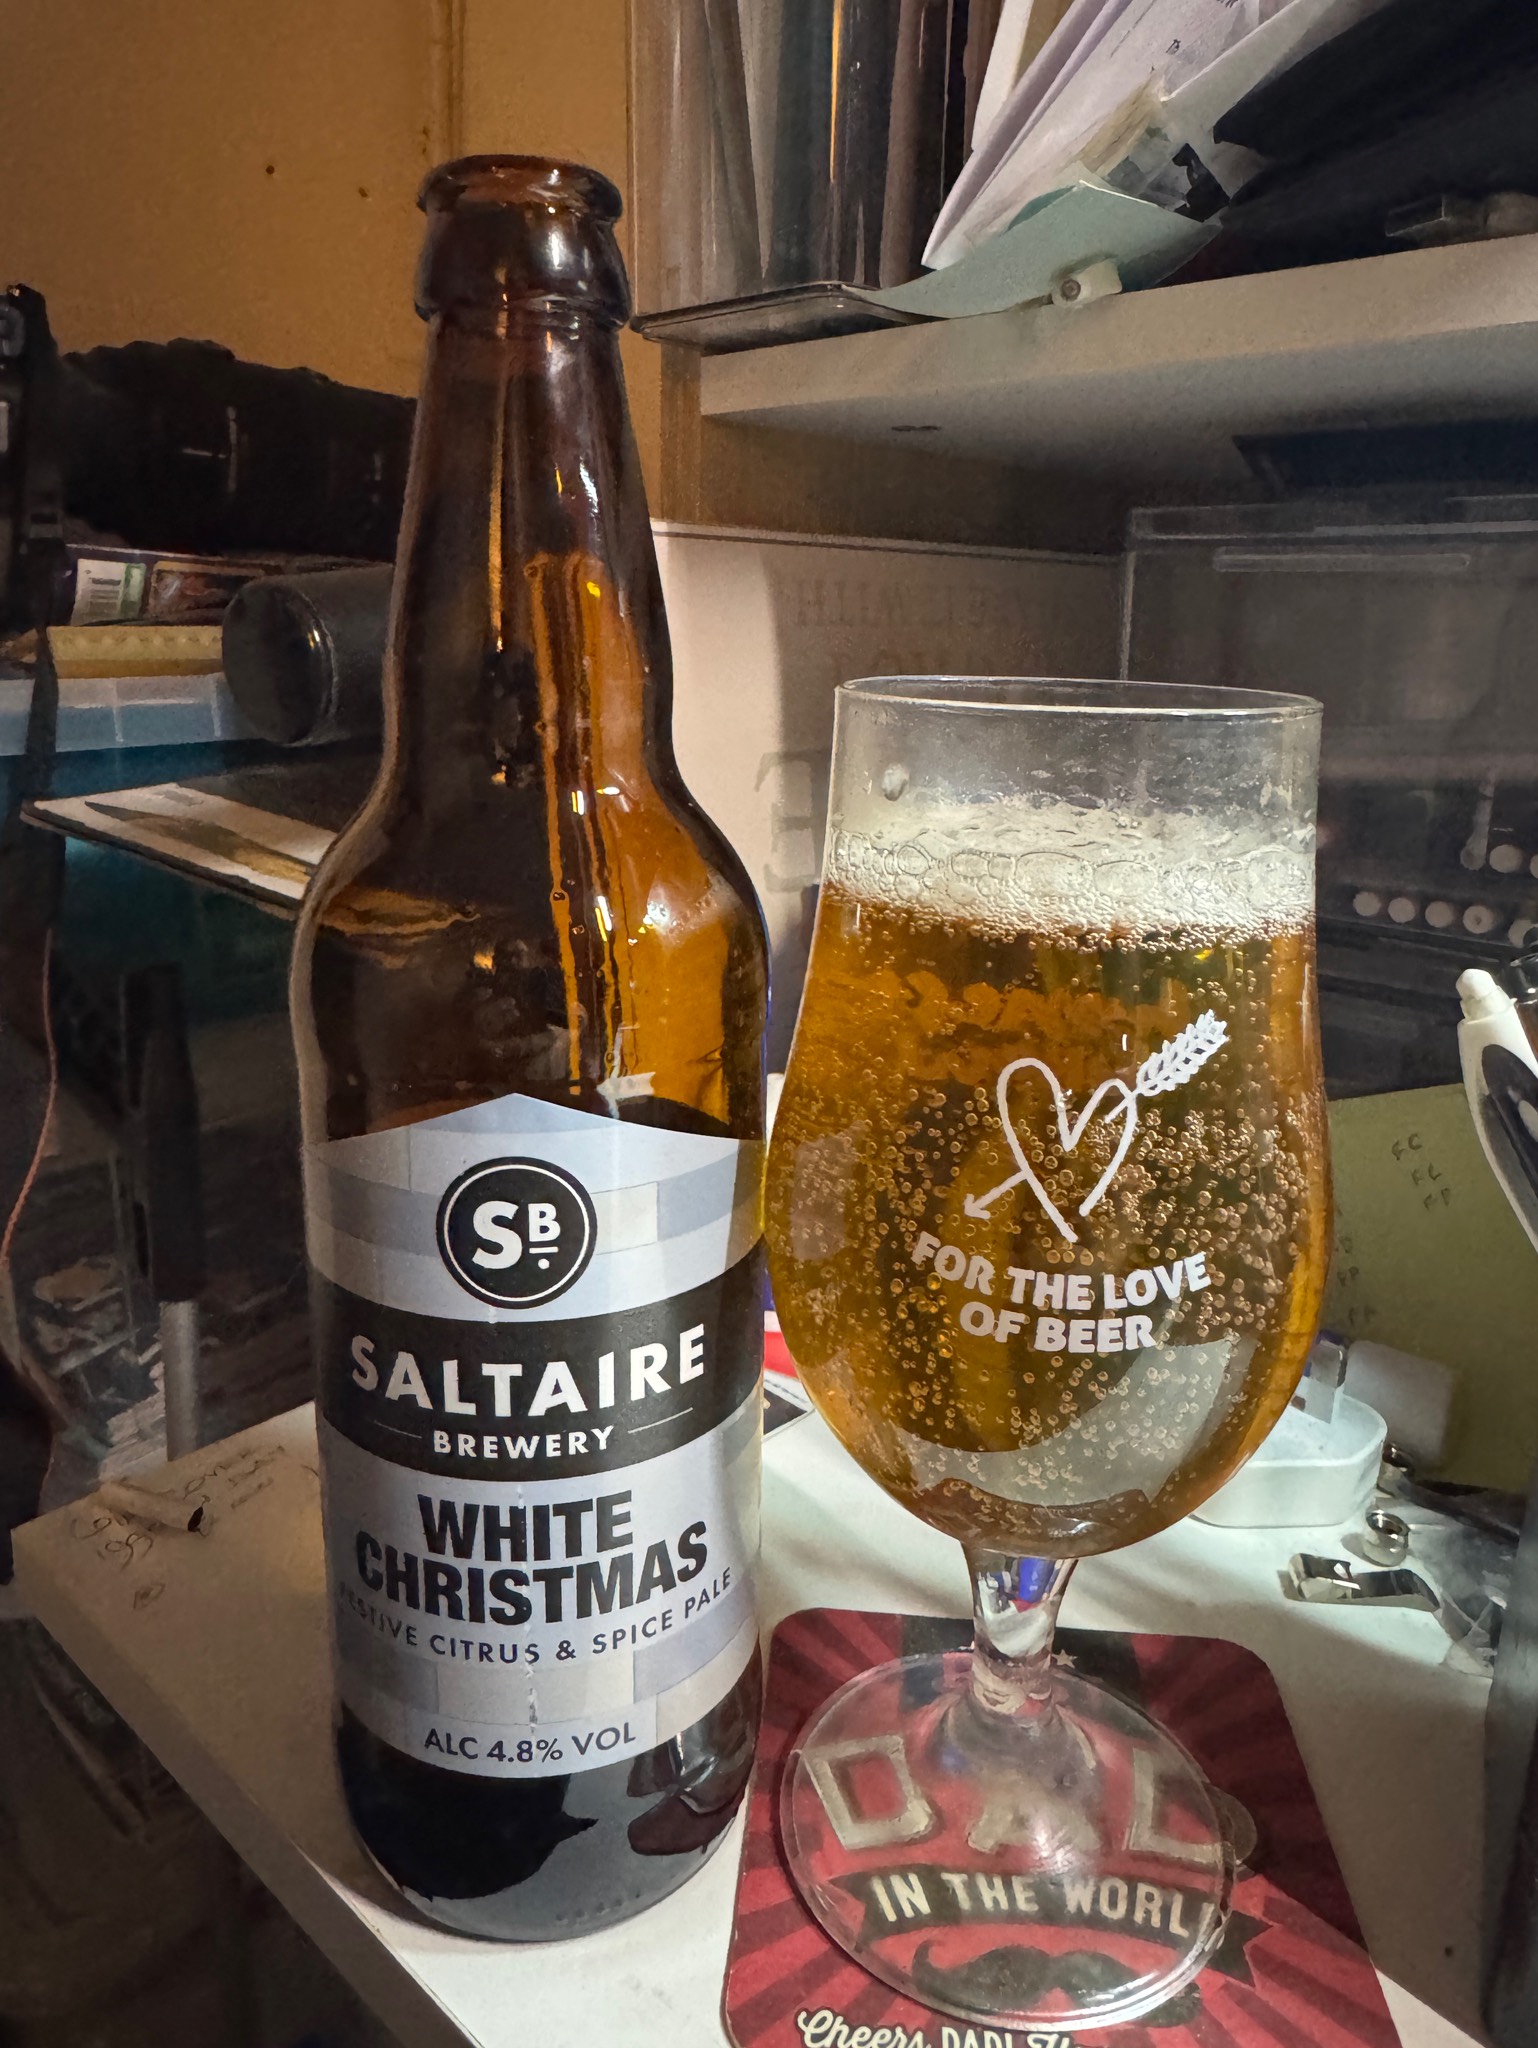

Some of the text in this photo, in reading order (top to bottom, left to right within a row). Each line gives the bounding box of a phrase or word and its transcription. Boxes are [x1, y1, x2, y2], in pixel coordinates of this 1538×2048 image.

[911, 1231, 1212, 1311] FOR THE LOVE
[960, 1301, 1157, 1354] OF BEER
[351, 1323, 705, 1418] SALTAIRE
[434, 1425, 614, 1459] BREWERY
[417, 1489, 634, 1562] WHITE
[356, 1520, 708, 1626] CHRISTMAS
[429, 1634, 540, 1665] CITRUS
[555, 1639, 577, 1661] &
[592, 1608, 673, 1655] SPICE
[684, 1566, 732, 1619] PALE
[424, 1721, 637, 1763] ALC 4.8% VOL
[870, 1873, 932, 1923] IN
[941, 1872, 1040, 1914] THE
